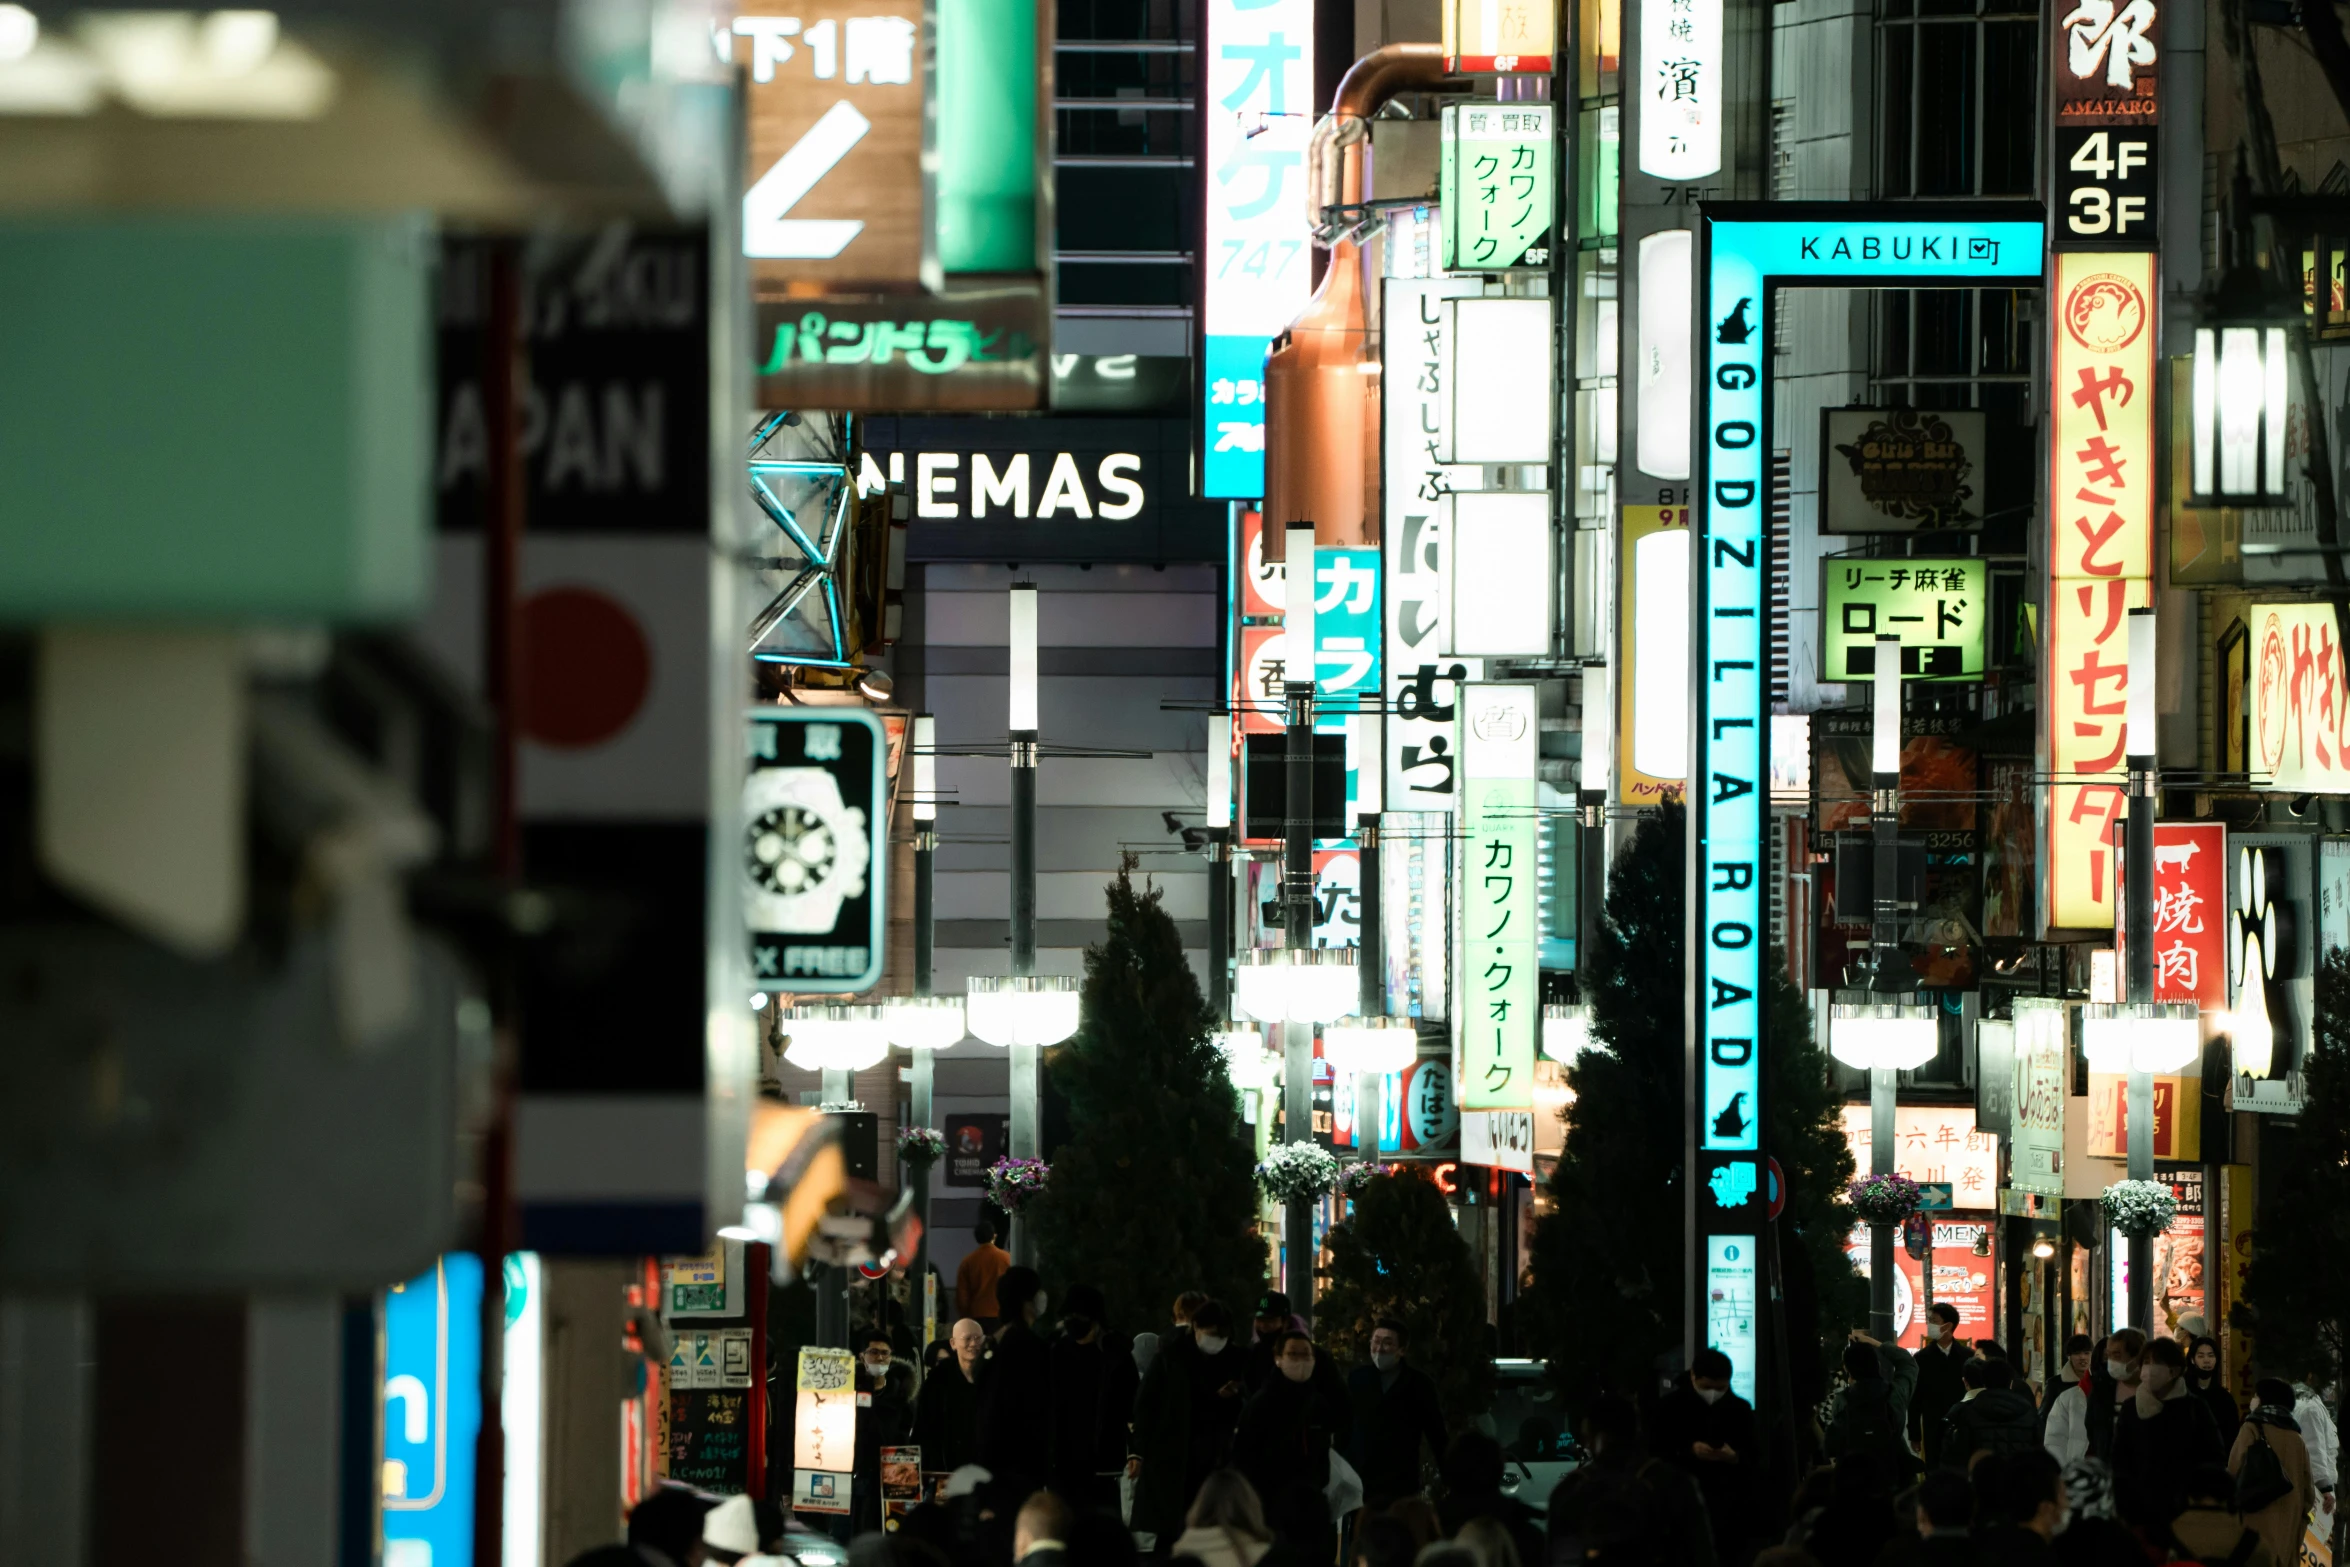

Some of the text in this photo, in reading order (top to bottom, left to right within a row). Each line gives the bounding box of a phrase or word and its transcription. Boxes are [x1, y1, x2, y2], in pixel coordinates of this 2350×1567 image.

[711, 15, 918, 85] 下1階
[1494, 55, 1519, 72] 6F
[1658, 57, 1702, 103] 濱
[1217, 0, 1302, 221] オケ
[2061, 98, 2157, 116] AMATARO
[2070, 132, 2148, 180] 4F
[1660, 187, 1702, 206] 7F
[2068, 187, 2147, 235] 3F
[1217, 239, 1303, 281] 747
[1525, 248, 1550, 265] 5F
[1712, 363, 1757, 806] GODZILLA
[1845, 567, 1967, 592] リーチ麻雀
[1842, 598, 1968, 639] ロード
[2153, 882, 2205, 991] 焼肉
[1710, 862, 1754, 1068] ROAD
